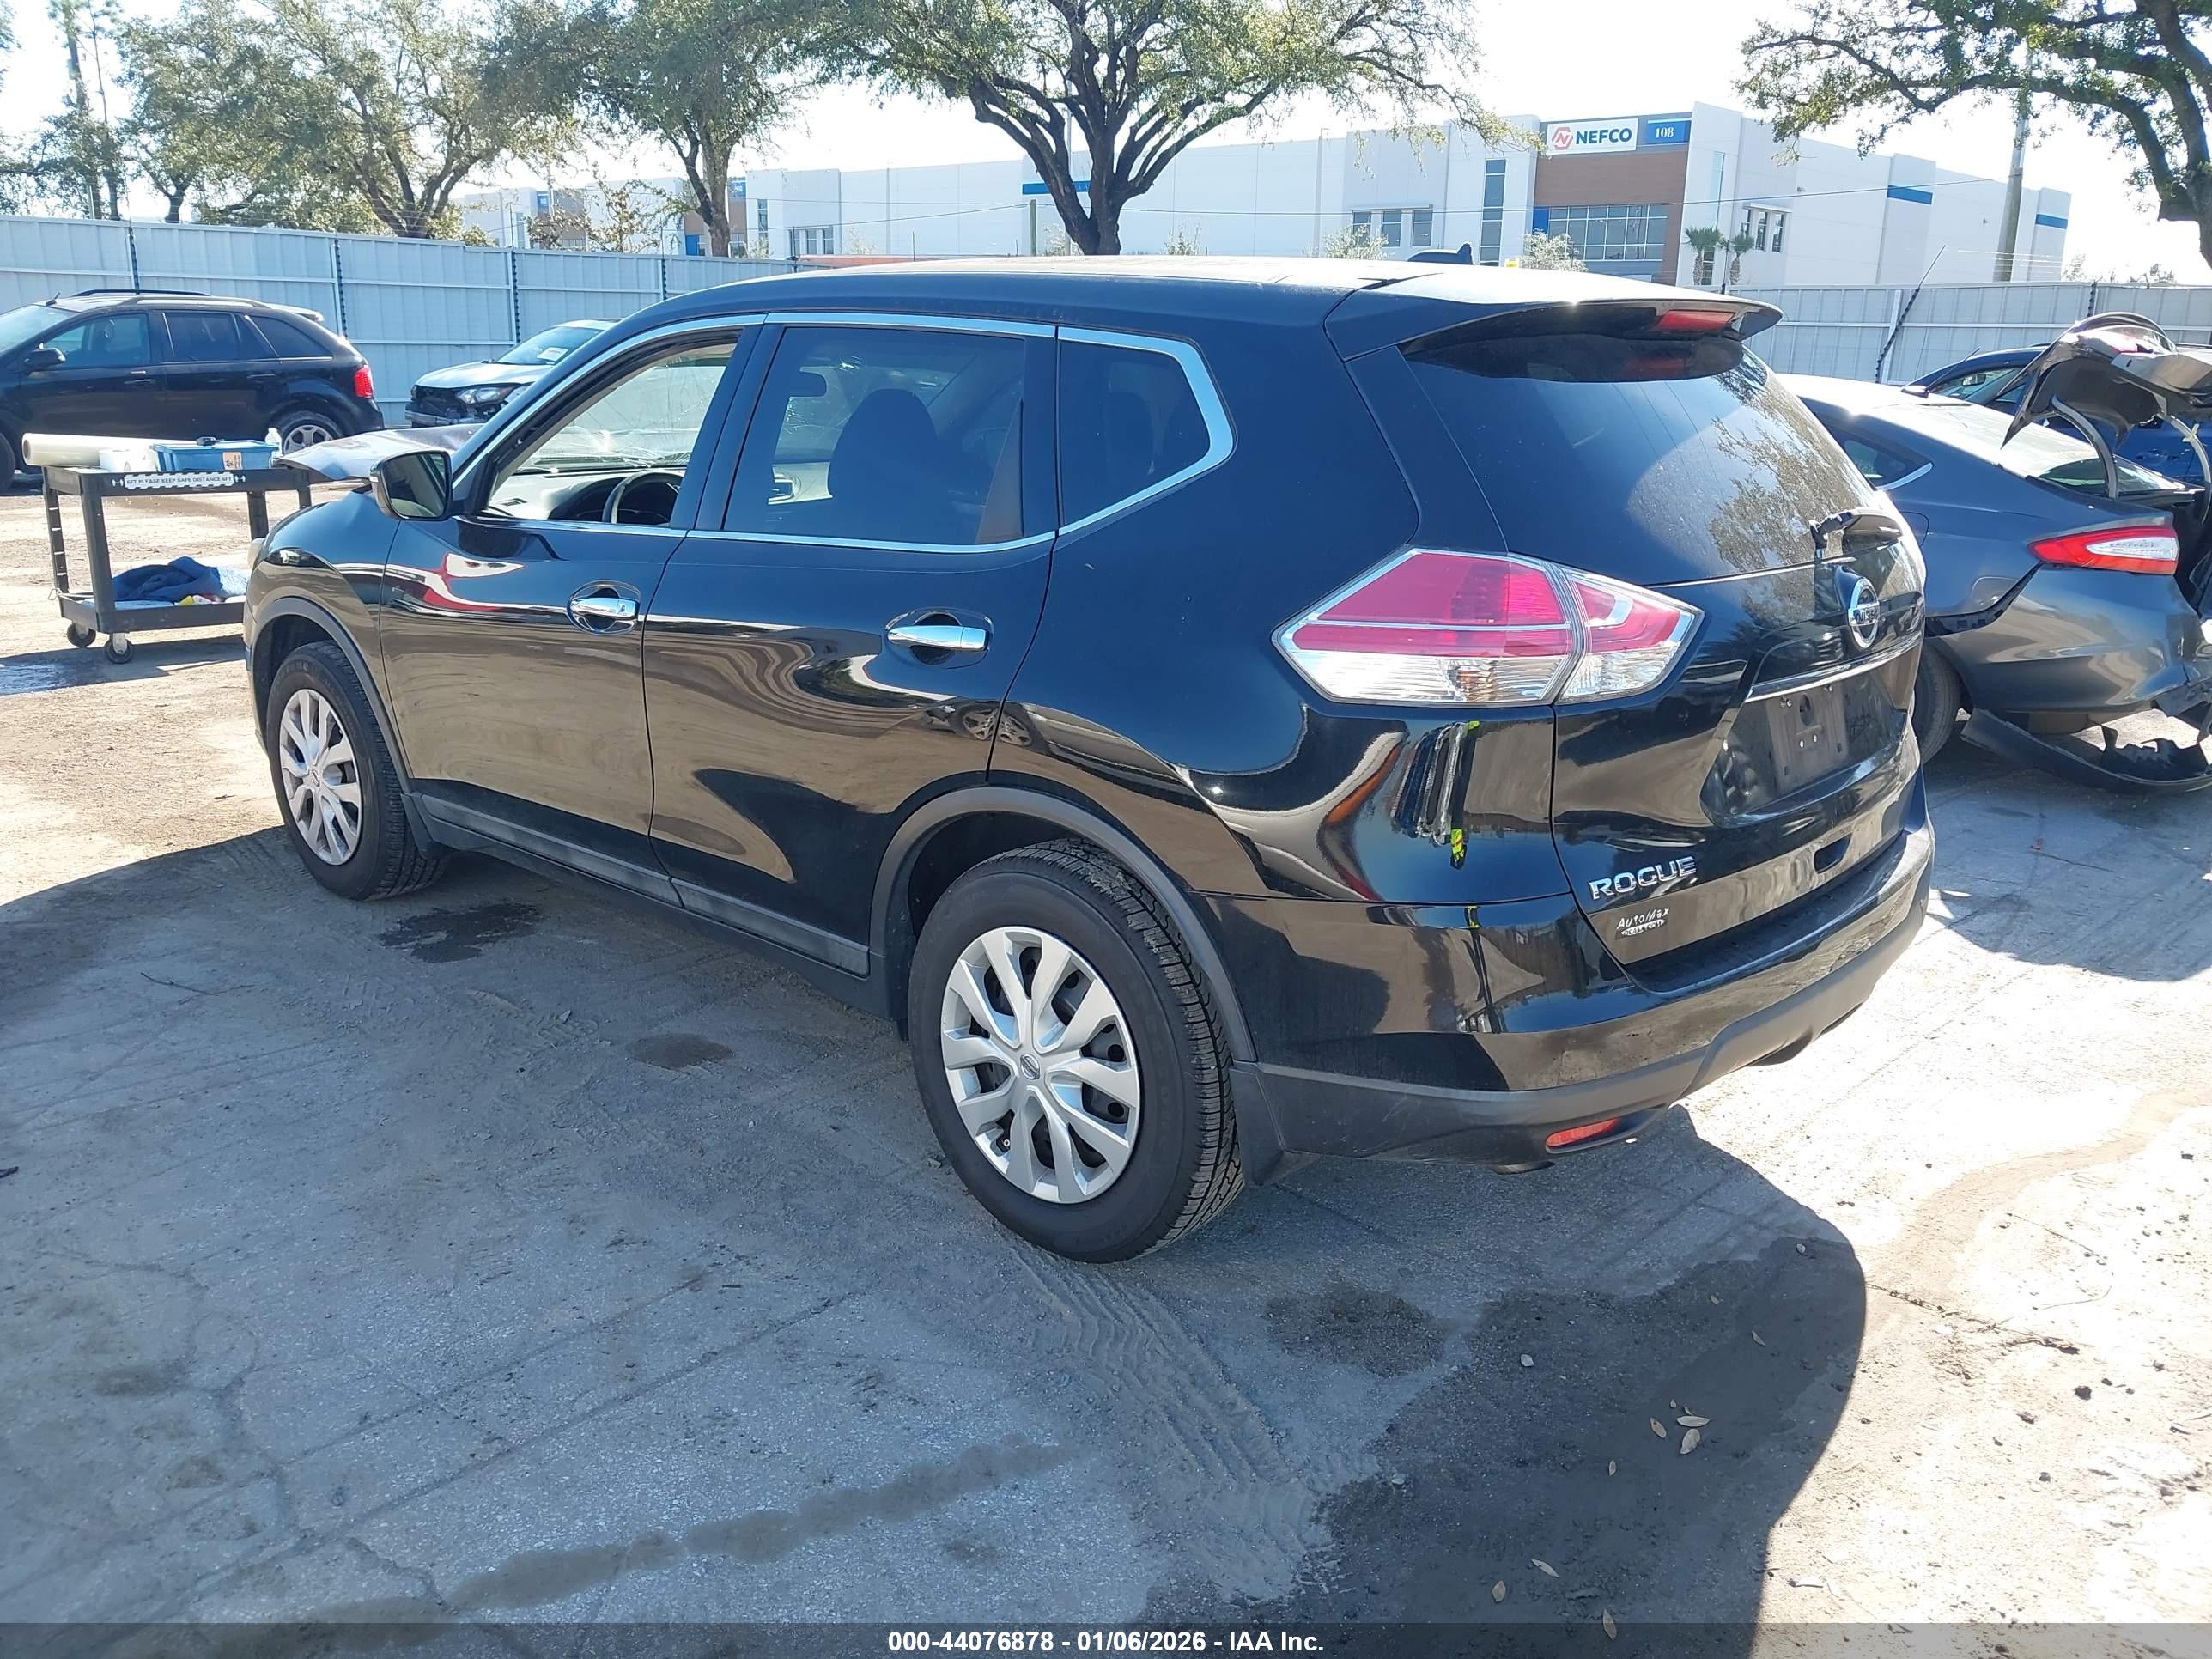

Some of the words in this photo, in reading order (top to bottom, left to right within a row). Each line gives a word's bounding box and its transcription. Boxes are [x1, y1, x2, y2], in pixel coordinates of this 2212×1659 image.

[1576, 127, 1632, 145] NEFCO
[1655, 126, 1674, 138] 108
[1589, 856, 1697, 900] ROGUE
